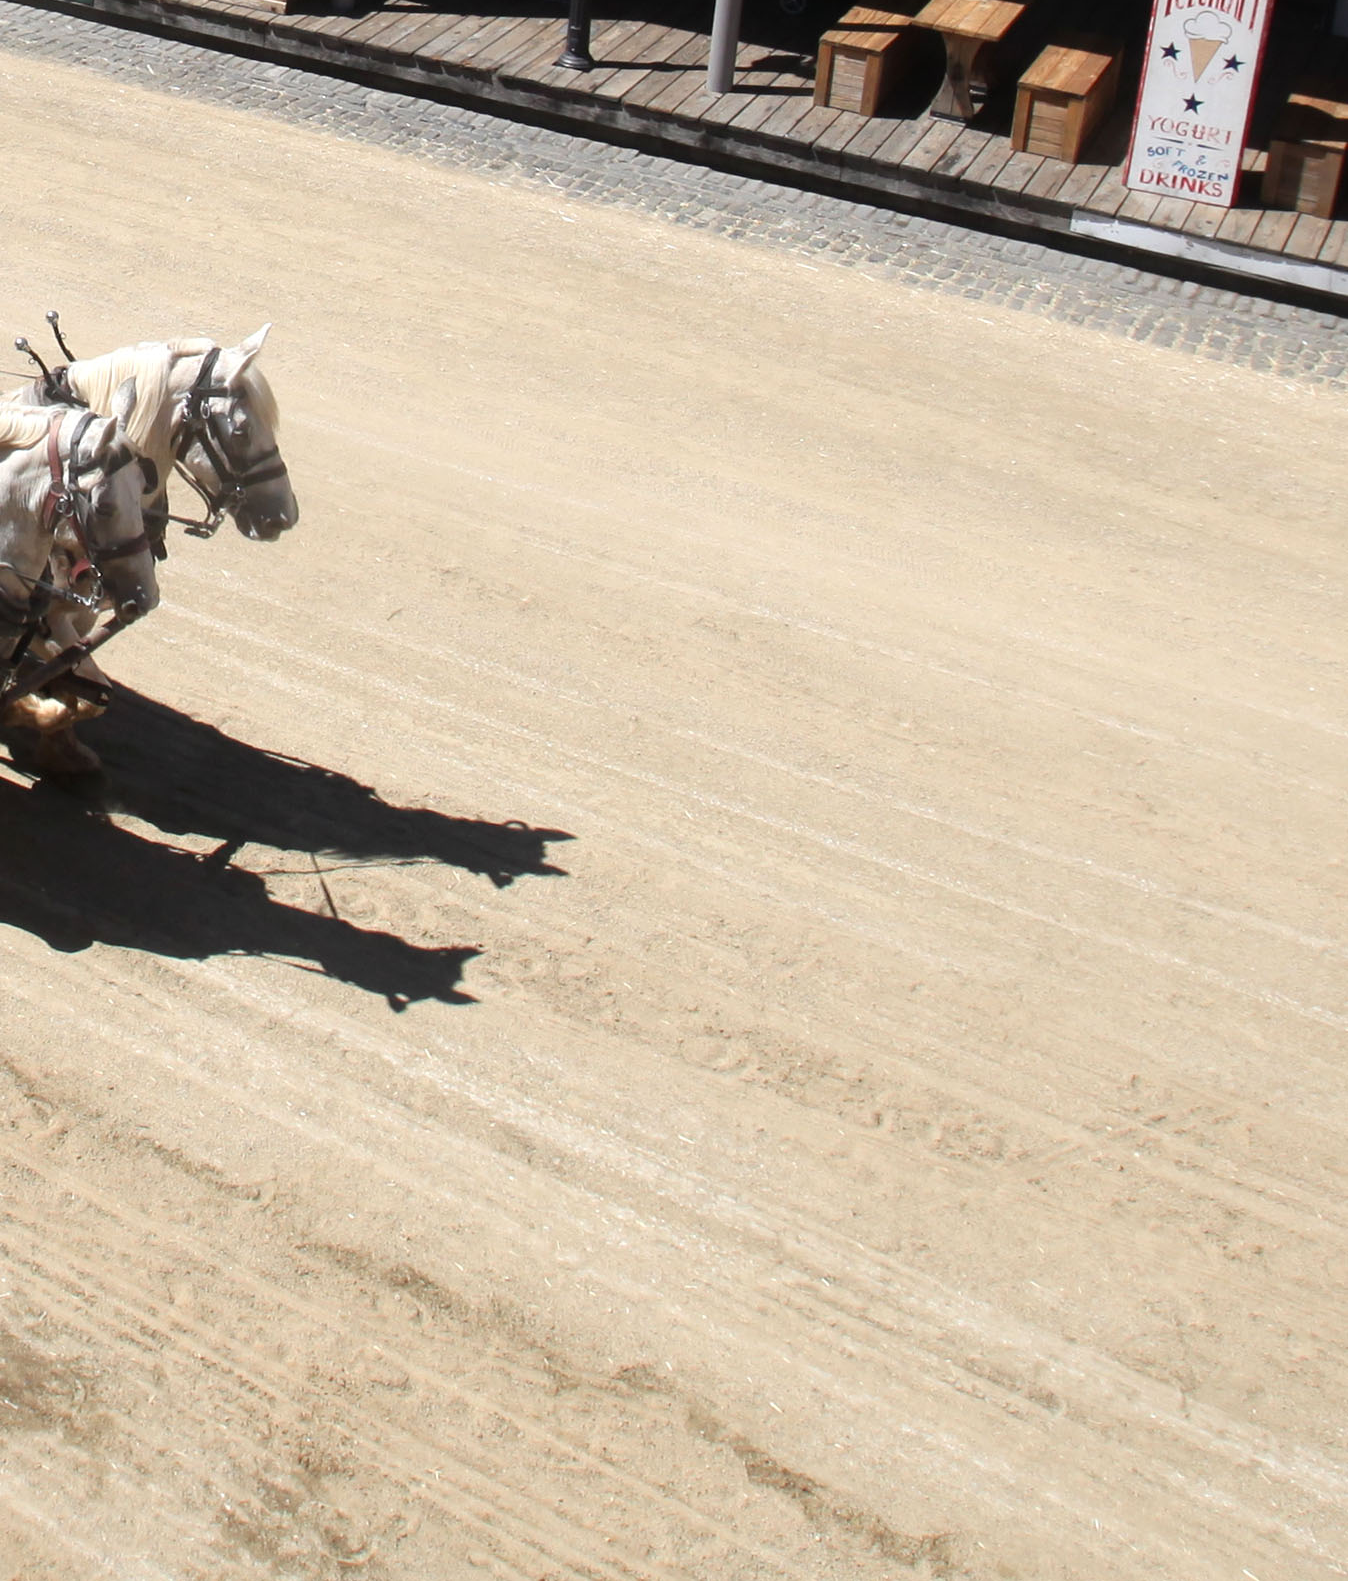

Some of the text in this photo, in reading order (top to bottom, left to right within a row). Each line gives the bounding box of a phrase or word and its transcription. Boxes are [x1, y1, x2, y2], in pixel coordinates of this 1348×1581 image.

[1148, 115, 1234, 145] YOGURT
[1139, 168, 1223, 198] DRINKS
[1172, 160, 1229, 181] FROZEN
